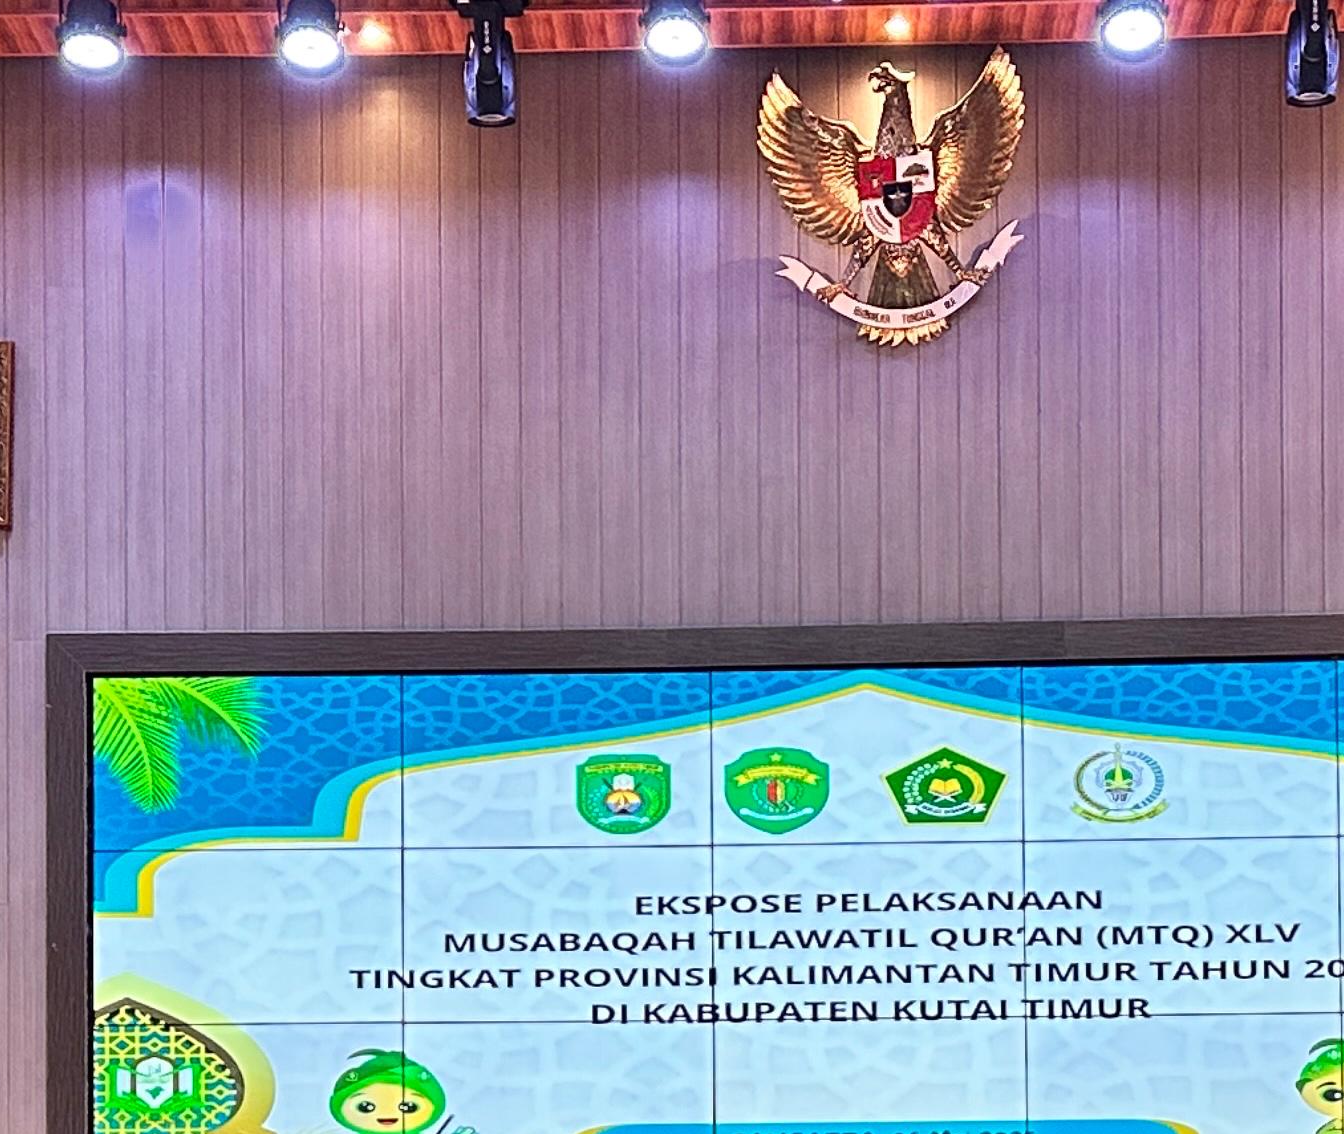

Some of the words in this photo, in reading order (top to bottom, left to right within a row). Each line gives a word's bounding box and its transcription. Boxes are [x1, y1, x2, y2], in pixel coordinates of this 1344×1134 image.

[635, 894, 802, 916] EKSPOSE
[816, 890, 1103, 913] PELAKSANAAN
[444, 932, 695, 956] MUSABAQAH
[709, 928, 919, 950] TILAWATIL
[1097, 924, 1213, 950] (MTQ)
[1225, 923, 1301, 944] XLV
[349, 968, 521, 990] TINGKAT
[534, 967, 717, 989] PROVINSI
[733, 963, 995, 986] KALIMANTAN
[1007, 961, 1139, 983] TIMUR
[1149, 959, 1291, 982] TAHUN
[591, 1004, 630, 1026] DI
[643, 1000, 879, 1024] KABUPATEN
[891, 999, 1008, 1022] KUTAI
[1021, 998, 1153, 1021] TIMUR
